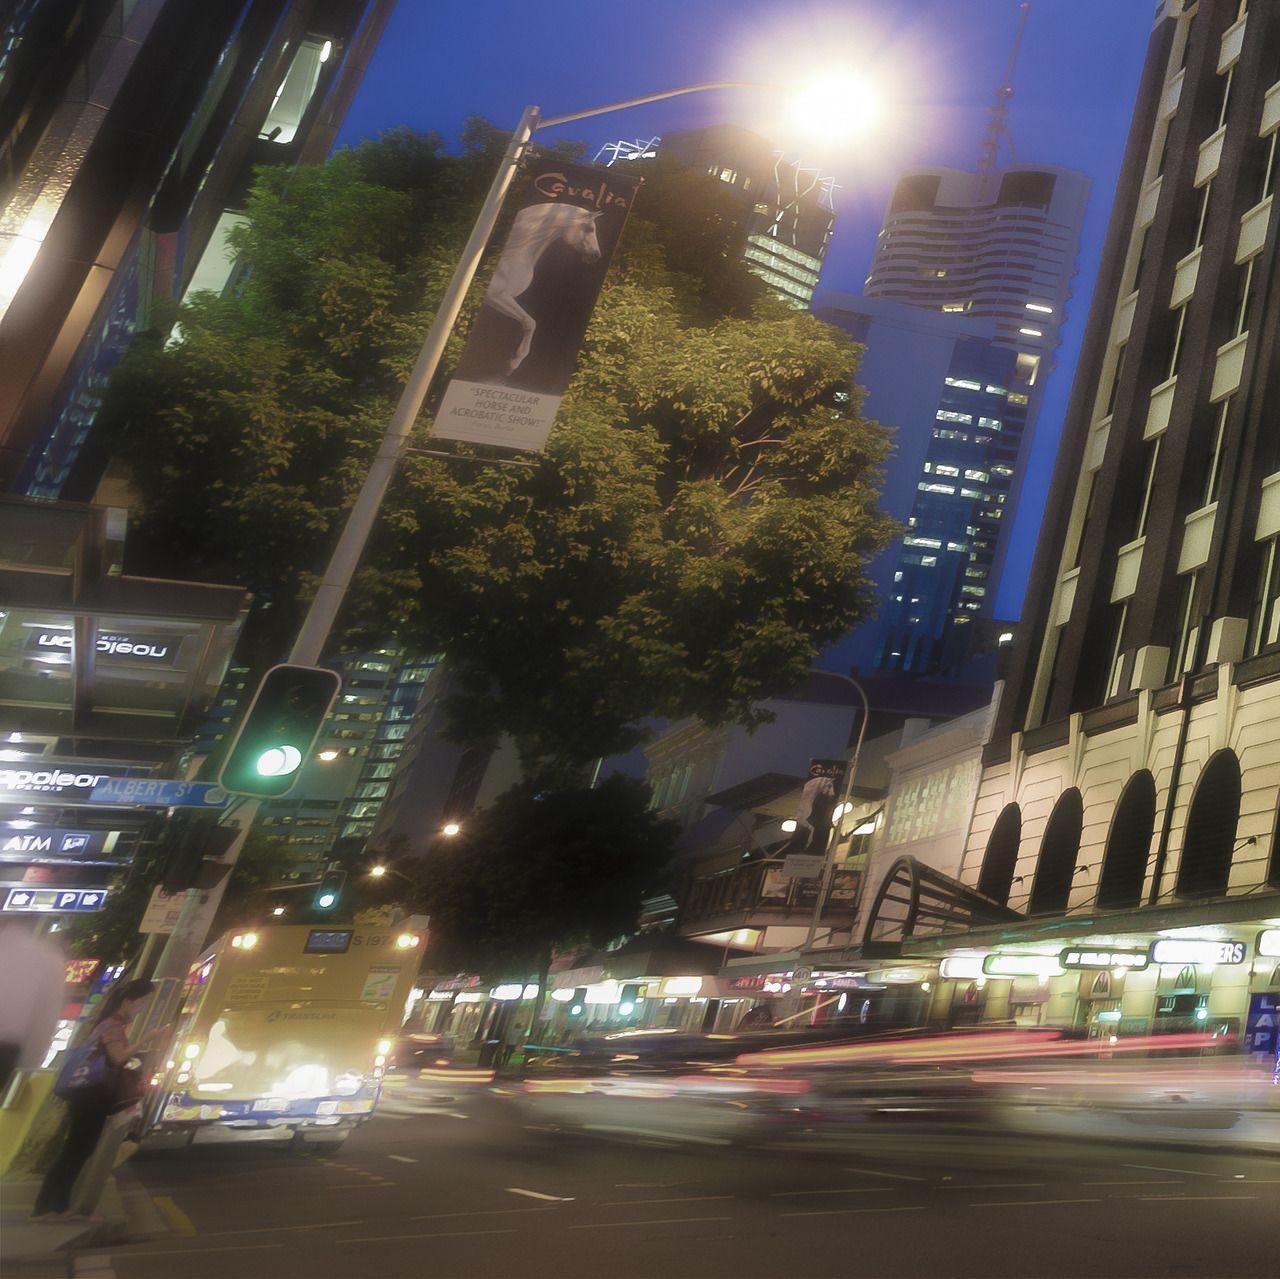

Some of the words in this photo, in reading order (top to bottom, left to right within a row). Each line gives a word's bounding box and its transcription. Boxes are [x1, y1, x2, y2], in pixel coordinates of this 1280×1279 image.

[534, 172, 627, 209] Cavalia
[449, 407, 506, 422] ACROBATIC
[474, 400, 508, 411] HORSE
[509, 405, 532, 414] AND
[102, 781, 169, 796] ALBERT
[176, 783, 195, 797] ST
[3, 834, 52, 851] ATM
[60, 893, 77, 908] P
[352, 935, 363, 946] S
